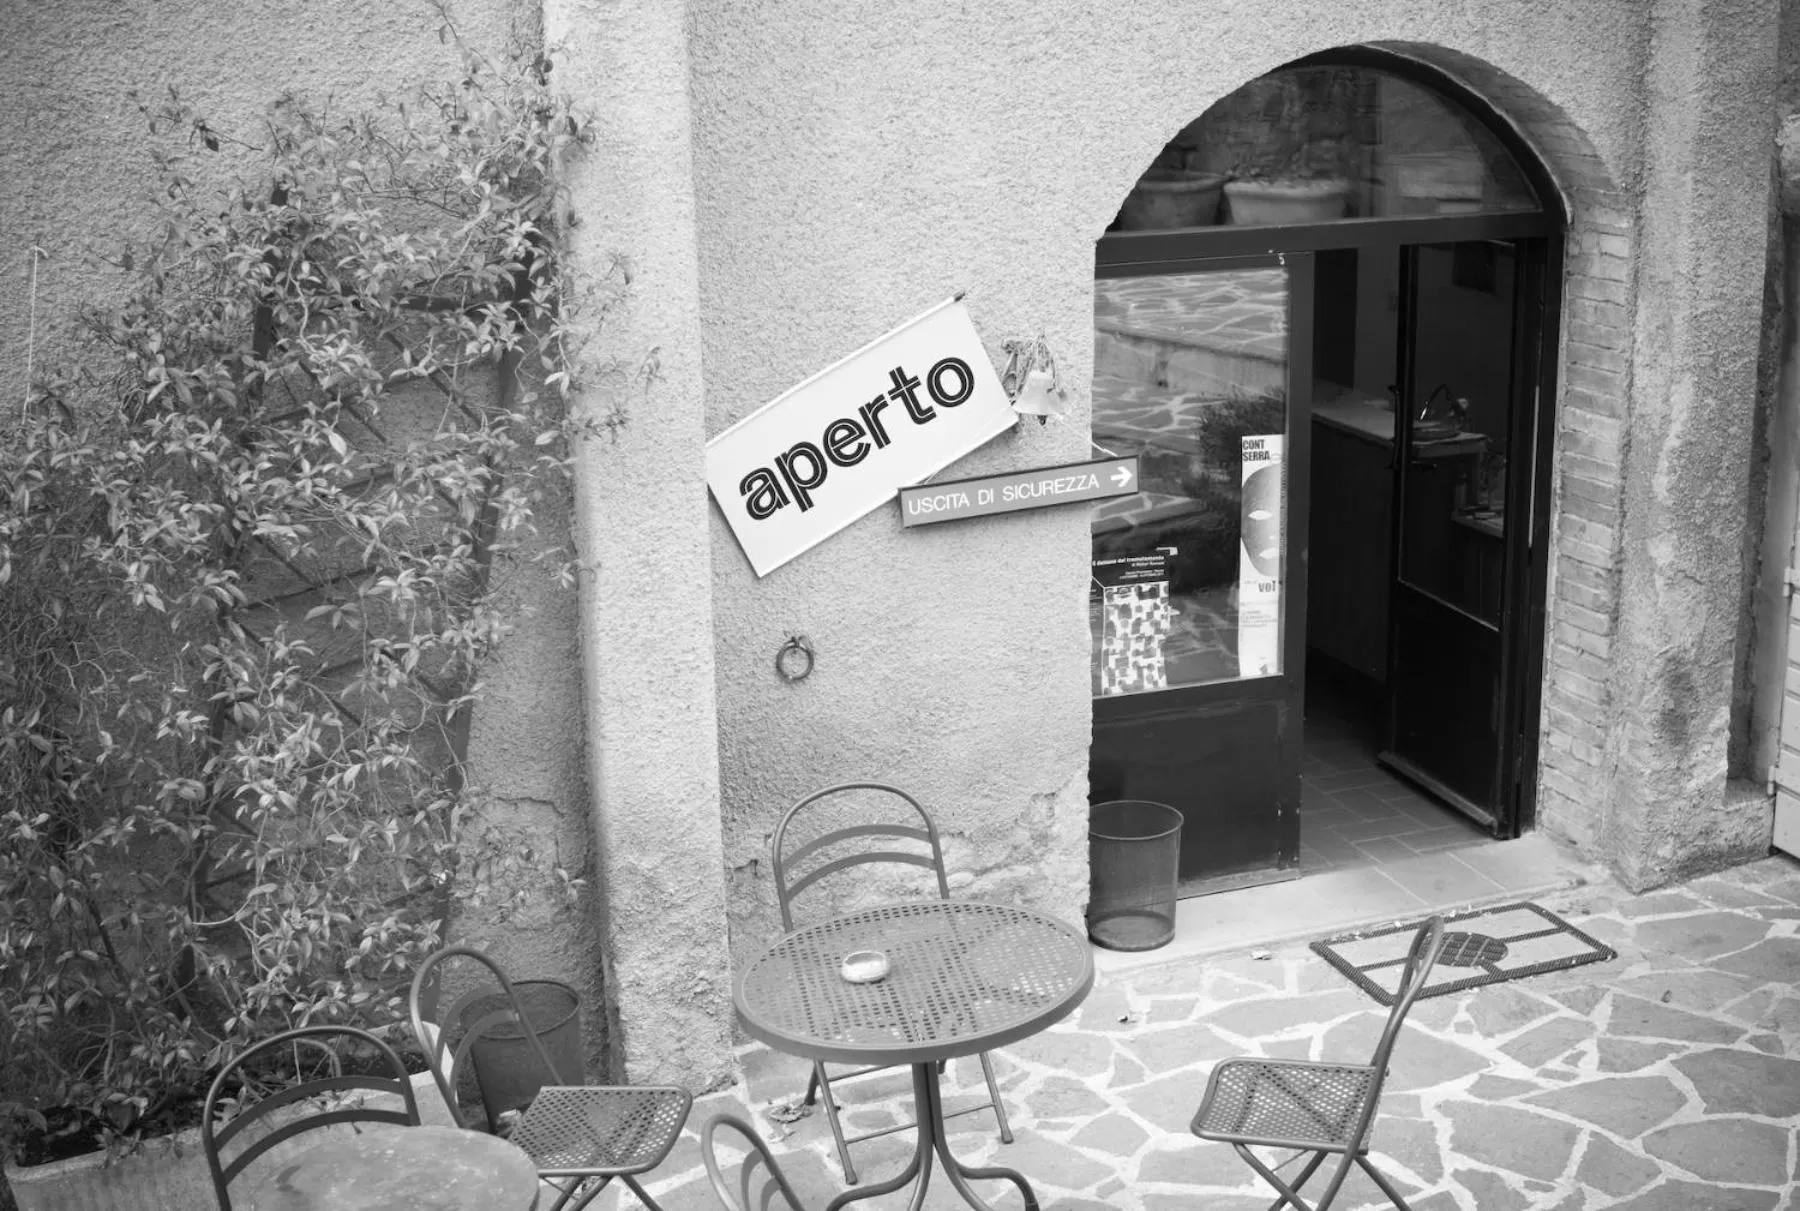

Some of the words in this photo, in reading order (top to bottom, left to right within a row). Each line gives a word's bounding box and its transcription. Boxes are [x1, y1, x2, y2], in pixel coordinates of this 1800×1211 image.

[739, 357, 975, 521] aperto
[1242, 439, 1265, 450] CONT
[1242, 450, 1271, 462] SERRA
[908, 492, 970, 515] USCITA
[978, 488, 994, 506] DI
[1002, 473, 1100, 502] SICUREZZA
